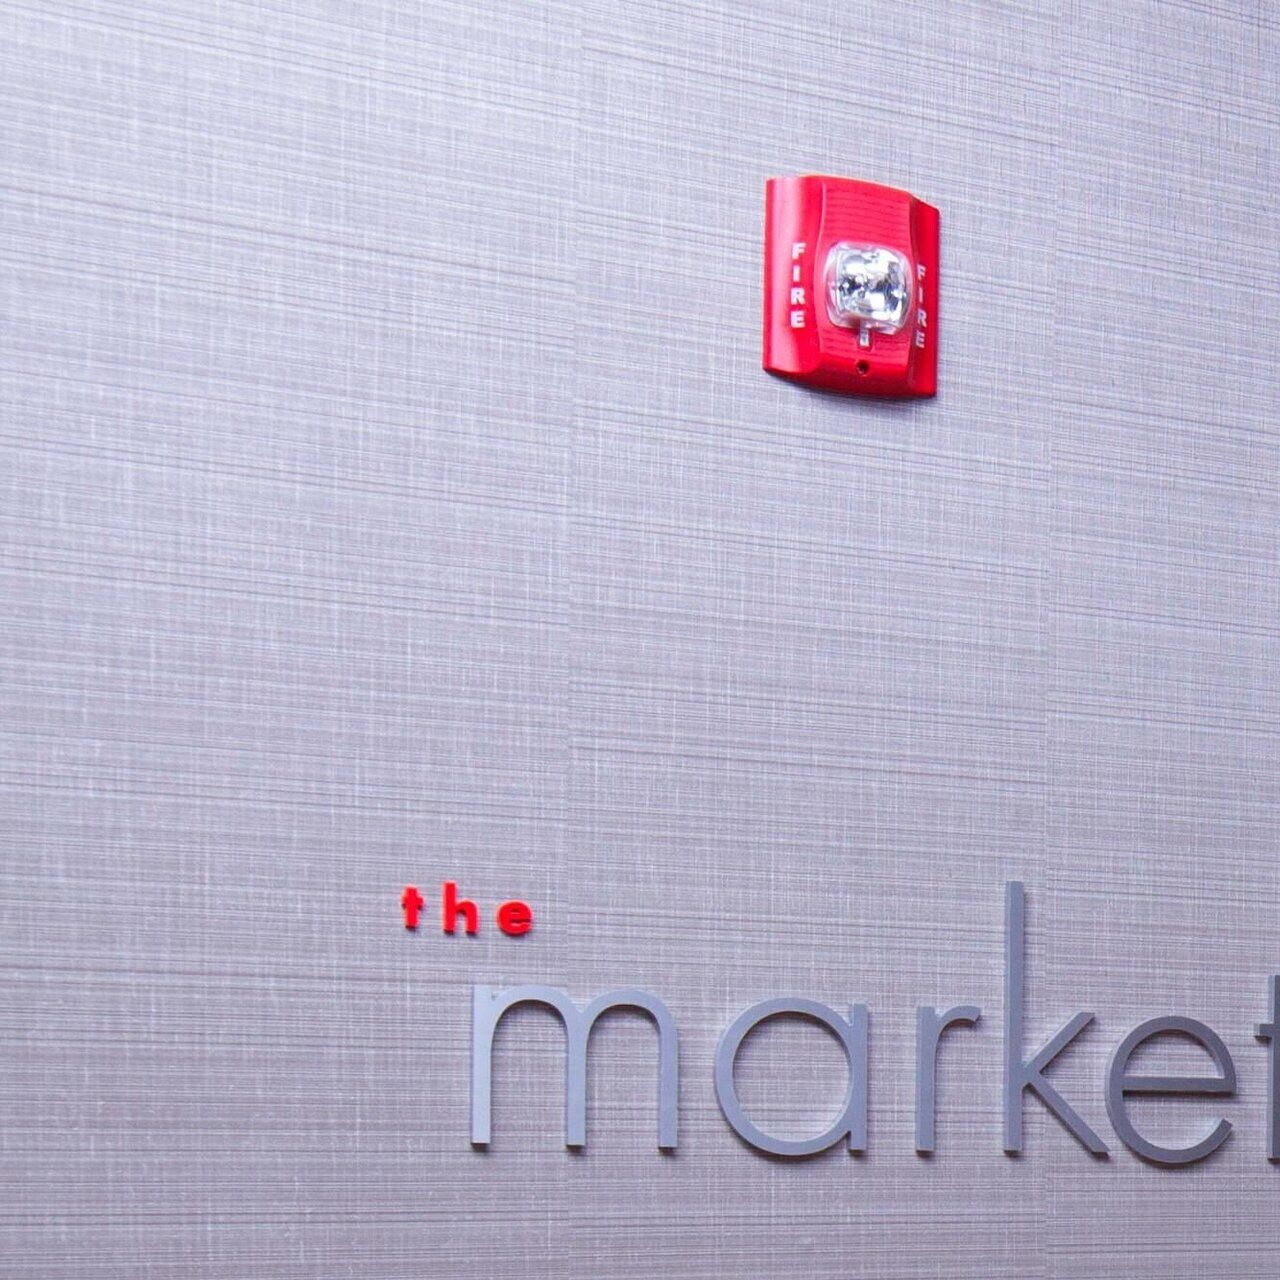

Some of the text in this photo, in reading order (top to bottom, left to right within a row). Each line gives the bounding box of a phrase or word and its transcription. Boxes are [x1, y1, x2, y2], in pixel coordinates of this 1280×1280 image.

[790, 242, 806, 329] FIRE
[915, 264, 928, 349] FIRE
[400, 881, 534, 937] the
